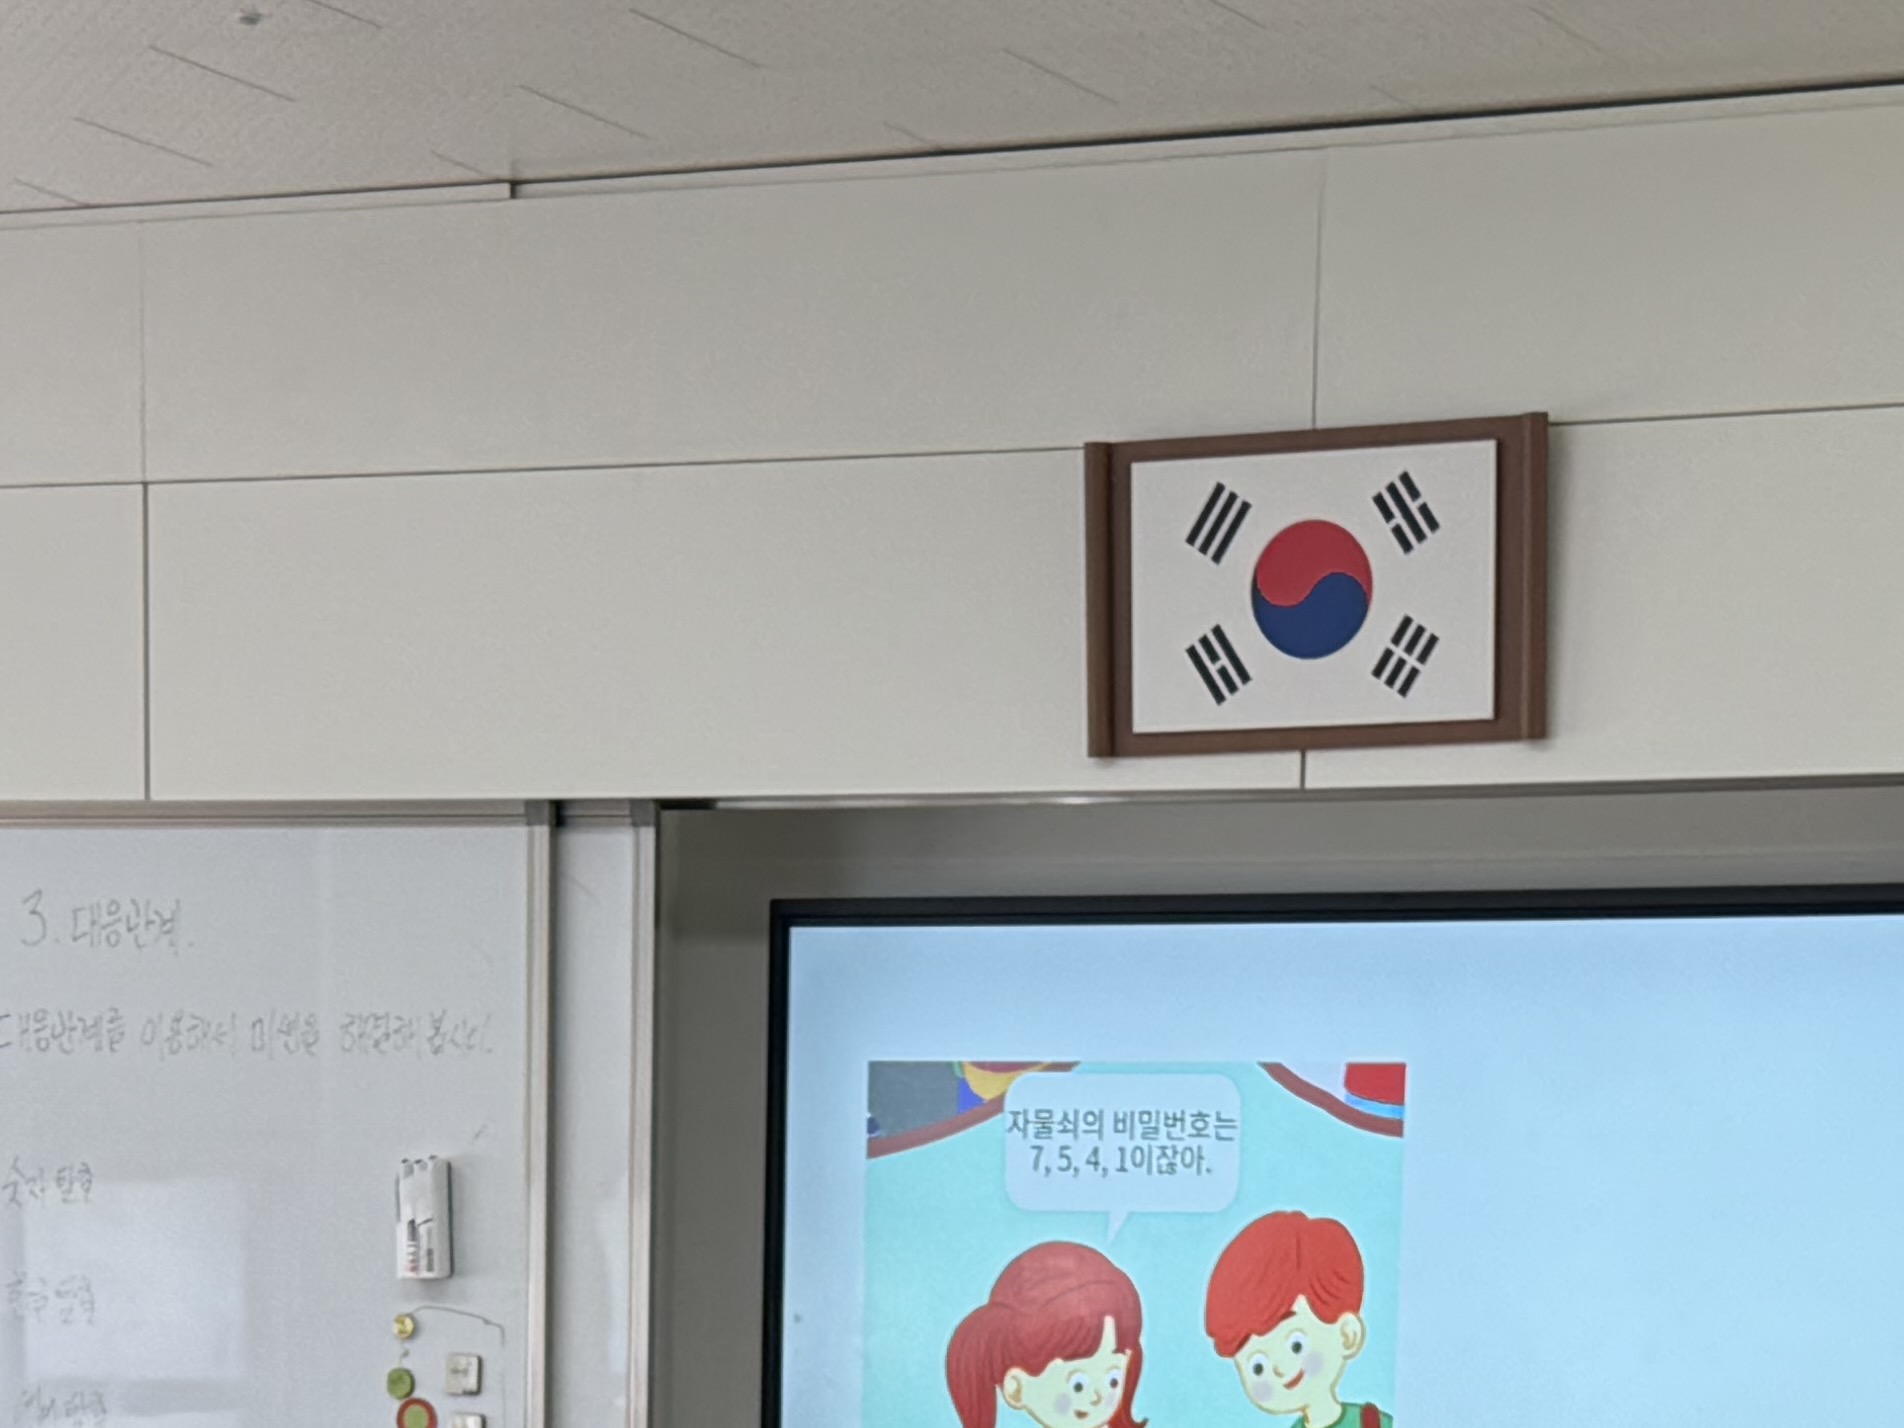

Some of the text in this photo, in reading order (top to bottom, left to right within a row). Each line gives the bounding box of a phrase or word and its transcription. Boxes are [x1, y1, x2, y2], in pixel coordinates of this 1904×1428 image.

[1006, 1108, 1238, 1142] 자물쇠의 비밀번호는
[1030, 1145, 1212, 1177] 7, 5, 4, 1이잖아.
